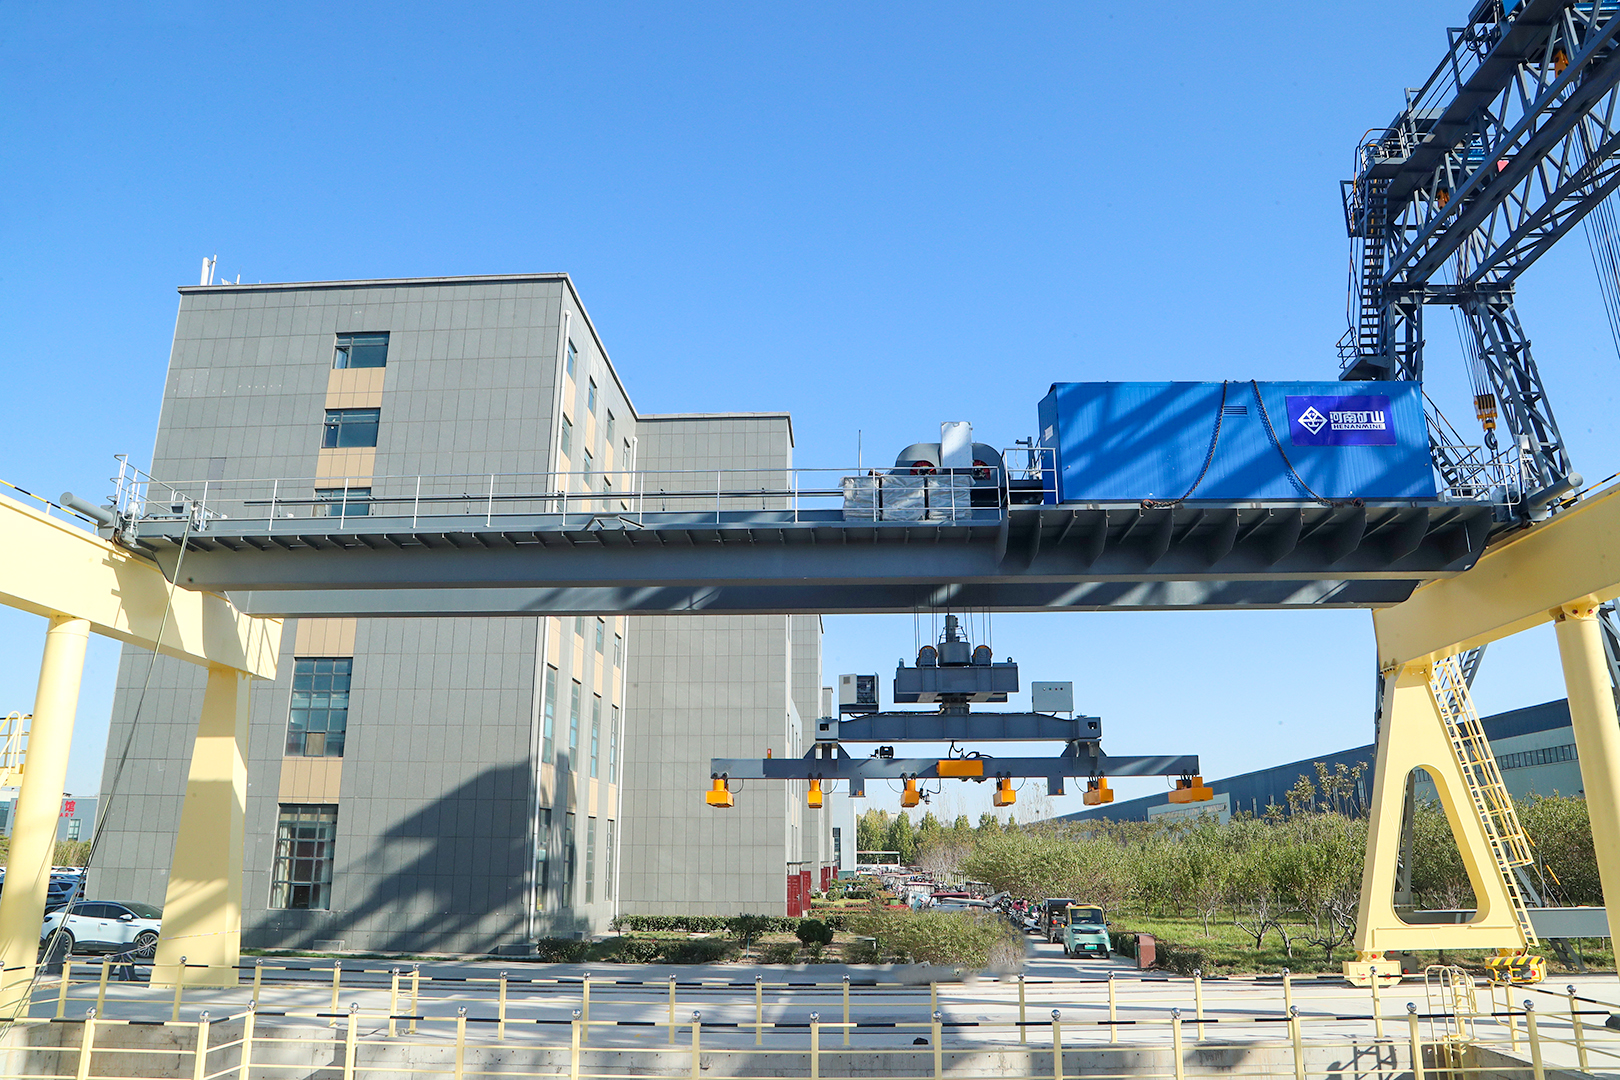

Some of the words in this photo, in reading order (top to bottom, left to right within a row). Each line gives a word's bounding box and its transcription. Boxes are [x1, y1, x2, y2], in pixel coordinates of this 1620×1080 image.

[1329, 411, 1385, 423] 河南矿山
[62, 800, 76, 812] 馆
